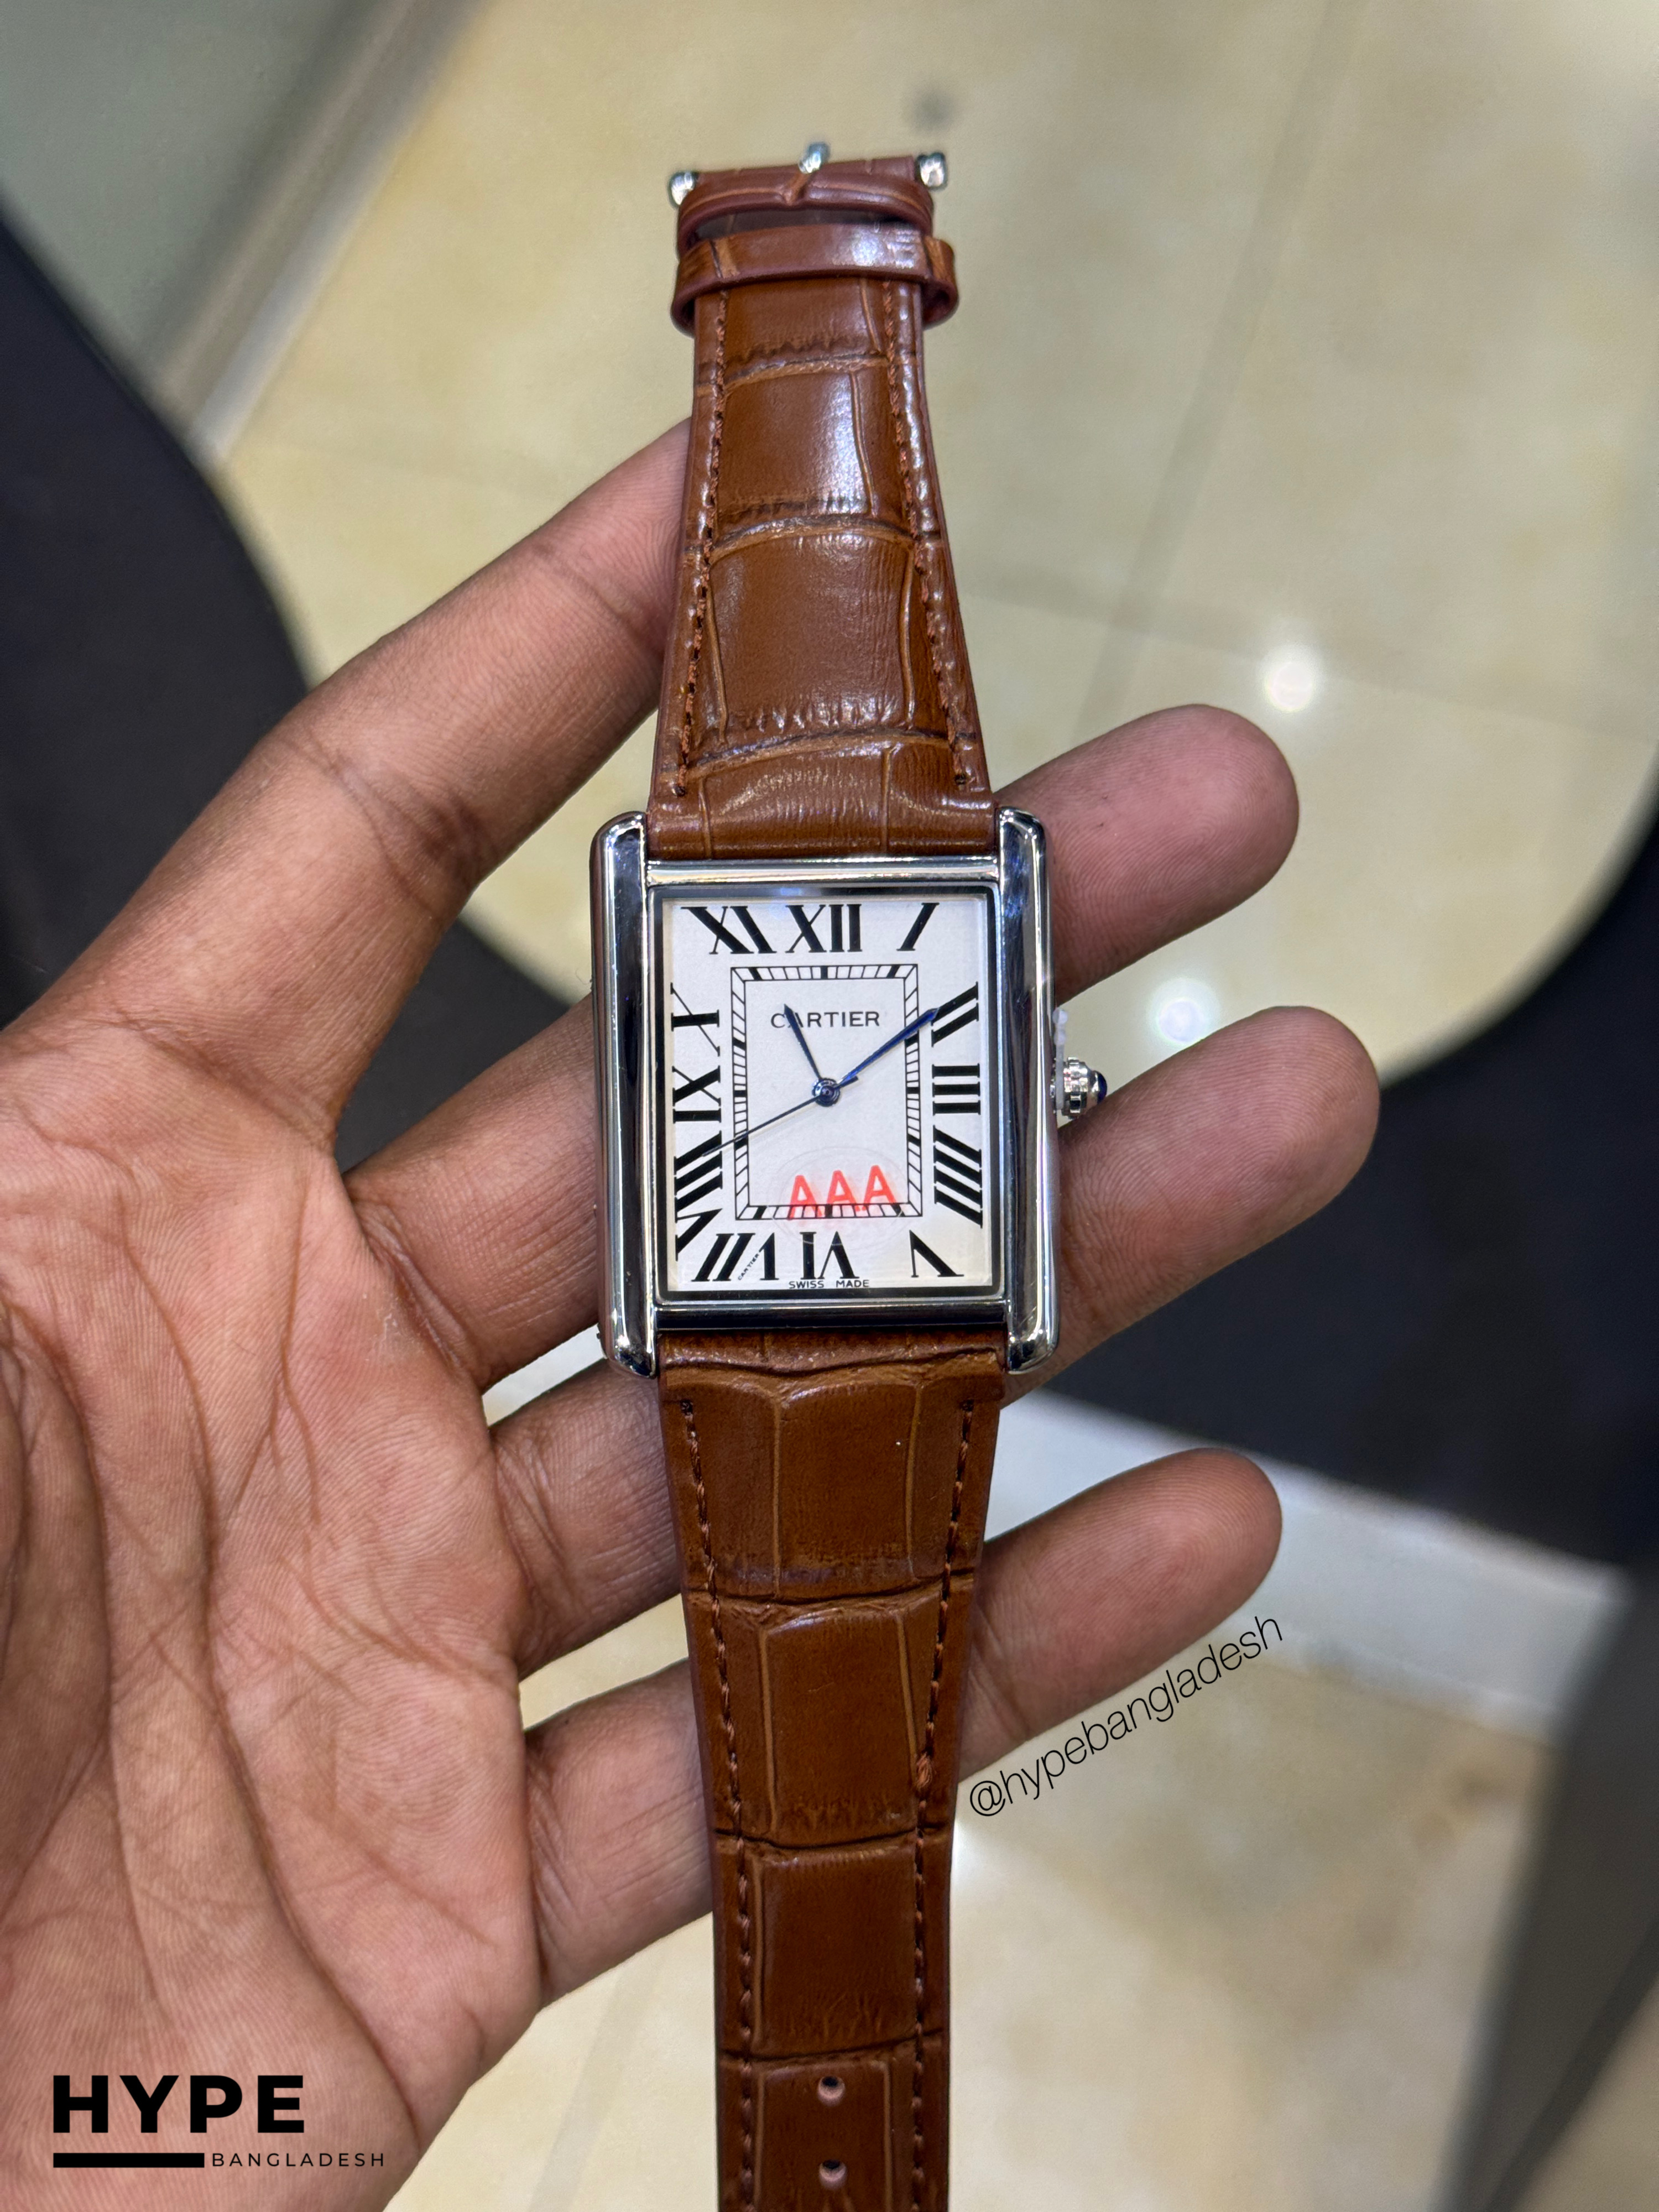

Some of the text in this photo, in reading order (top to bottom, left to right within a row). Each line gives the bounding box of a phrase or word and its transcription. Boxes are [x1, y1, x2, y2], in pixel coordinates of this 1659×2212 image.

[681, 902, 940, 954] XI XII I
[932, 1063, 981, 1116] III
[787, 1165, 898, 1220] AAA
[933, 1125, 983, 1229] IIII
[800, 1230, 860, 1280] VI
[789, 1280, 870, 1289] SWISS MADE
